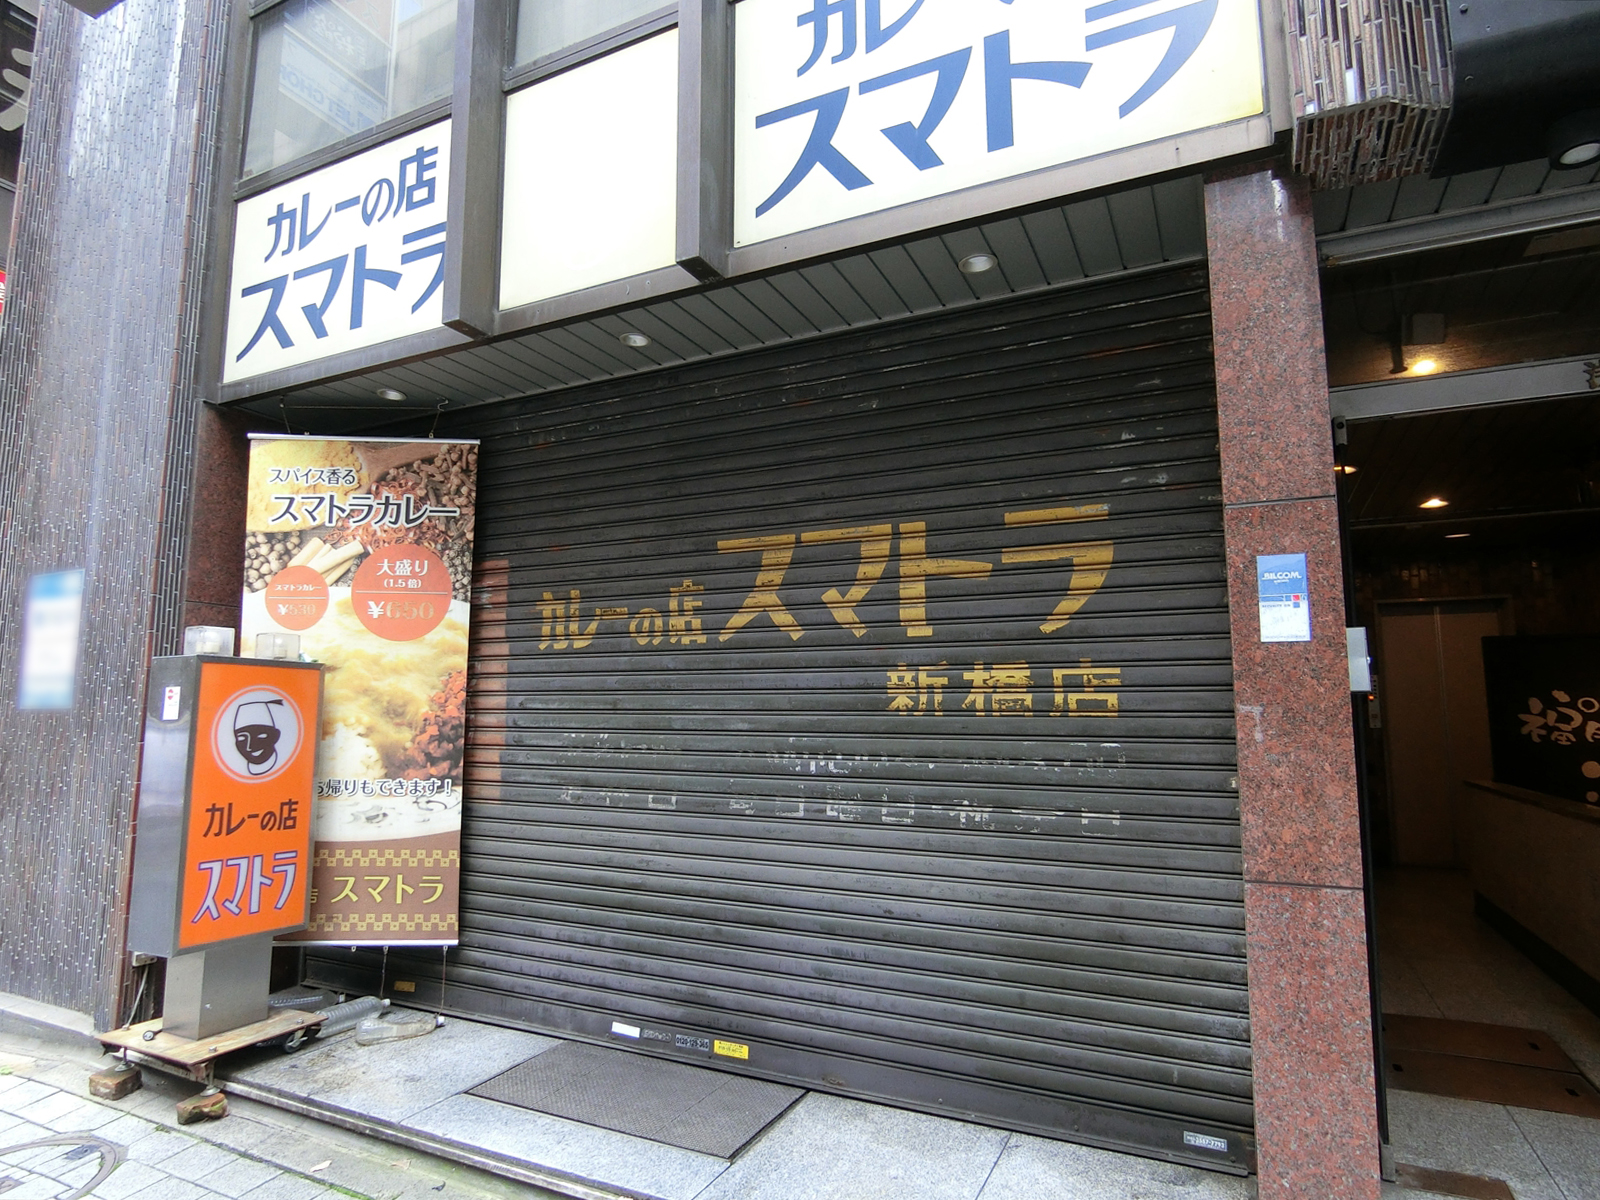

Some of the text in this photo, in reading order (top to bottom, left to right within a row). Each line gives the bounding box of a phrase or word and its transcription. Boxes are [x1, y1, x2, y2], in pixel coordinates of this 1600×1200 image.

[755, 0, 1219, 218] スマトラ
[264, 146, 439, 264] カレーの店
[236, 221, 447, 363] スマトラ
[269, 467, 357, 486] スパイス香る
[270, 493, 460, 527] スマトラカレー
[376, 558, 429, 577] 大盛り
[534, 503, 1114, 651] カレーの店 スマトラ
[274, 583, 322, 593] スマトラカレー
[368, 600, 435, 620] ¥650
[887, 657, 1122, 719] 新橋店
[203, 799, 299, 839] カレーの店
[191, 851, 299, 925] スマトラ
[330, 873, 445, 905] スマトラ
